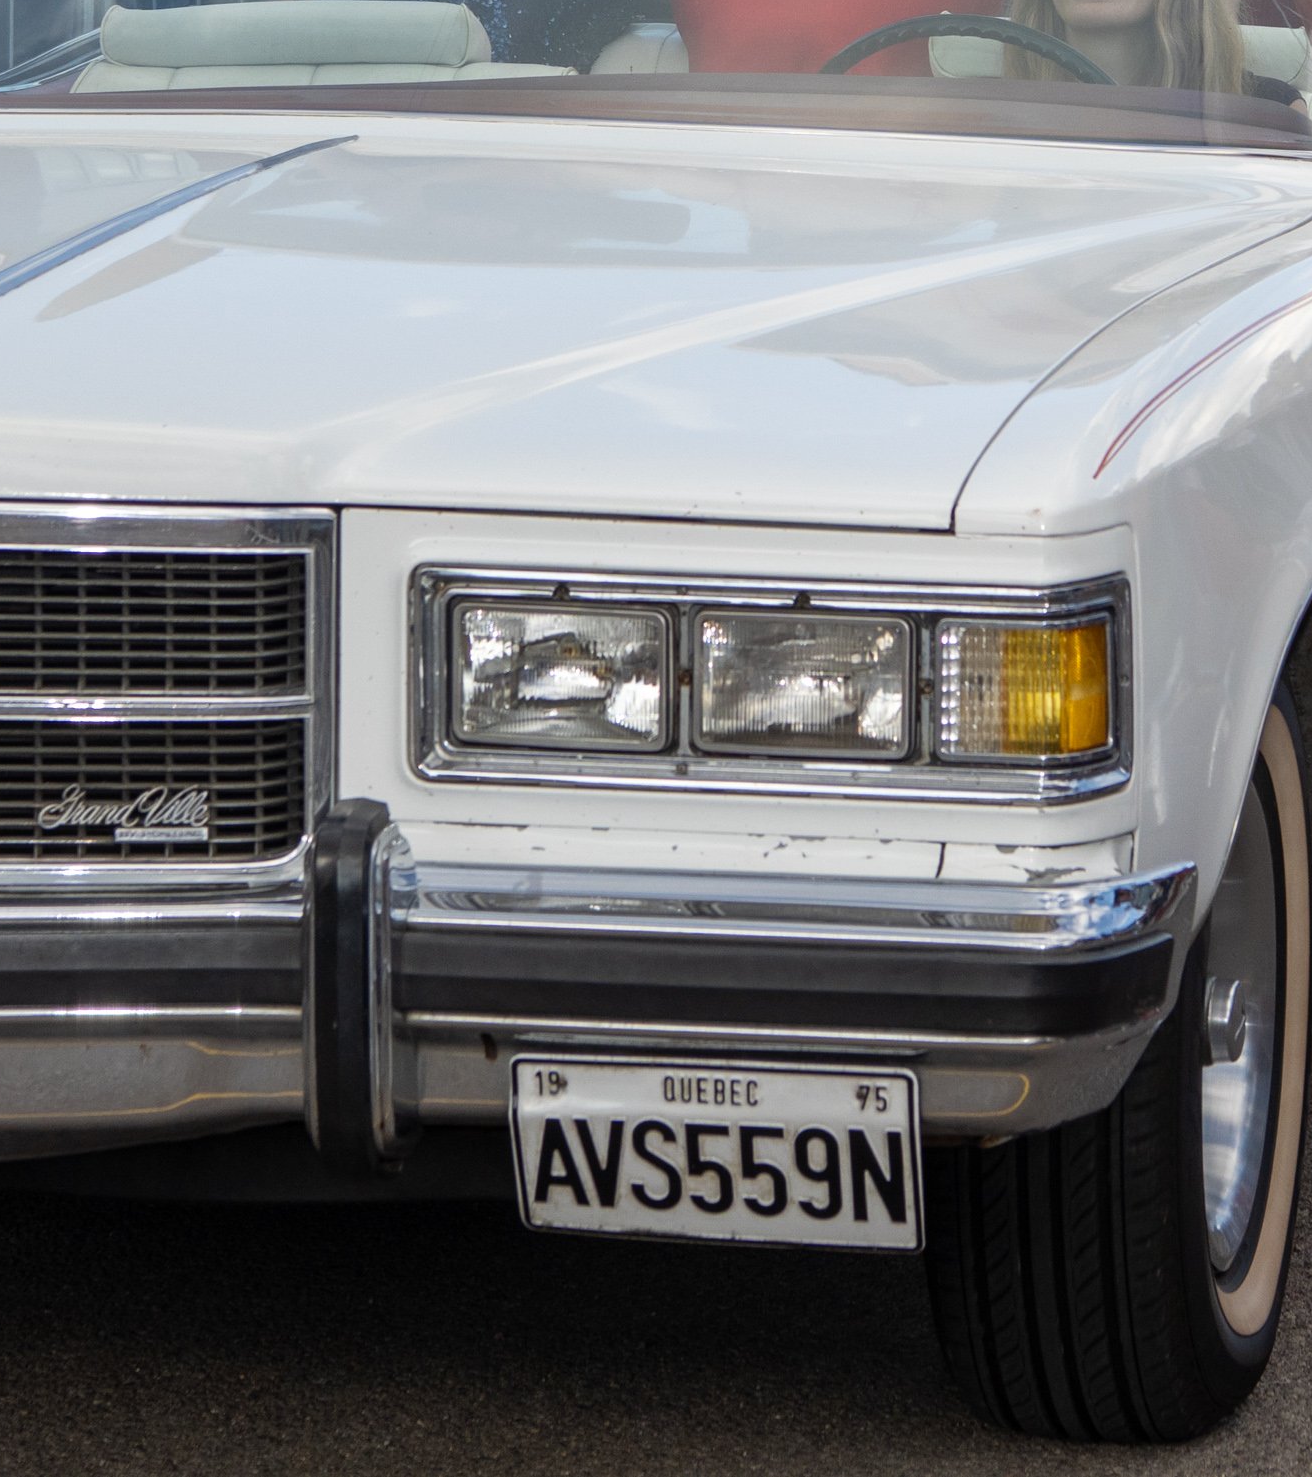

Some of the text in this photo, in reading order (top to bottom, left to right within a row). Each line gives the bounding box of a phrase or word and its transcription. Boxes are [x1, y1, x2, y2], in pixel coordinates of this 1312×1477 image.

[38, 783, 209, 829] Grand Ville
[535, 1071, 888, 1112] 19 QUEBEC 75
[534, 1118, 907, 1223] AVS559N
